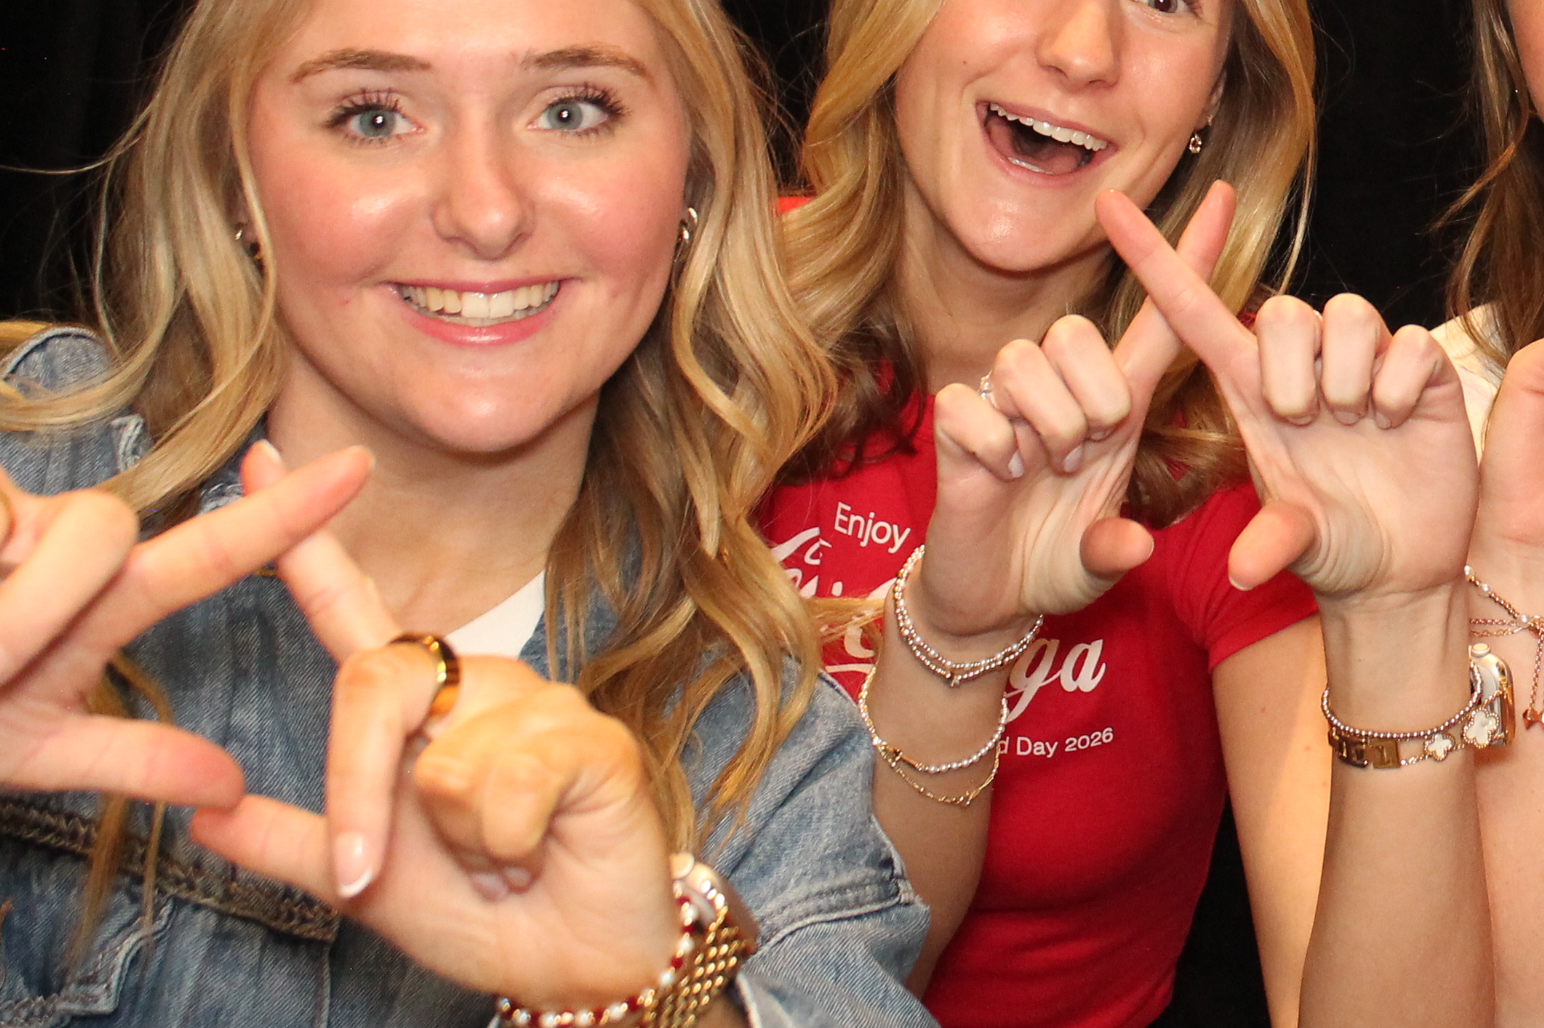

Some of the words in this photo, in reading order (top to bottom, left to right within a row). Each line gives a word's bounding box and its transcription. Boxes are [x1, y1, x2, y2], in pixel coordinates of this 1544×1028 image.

[834, 501, 912, 554] Enjoy
[1016, 736, 1059, 759] Day
[1064, 727, 1115, 752] 2026
